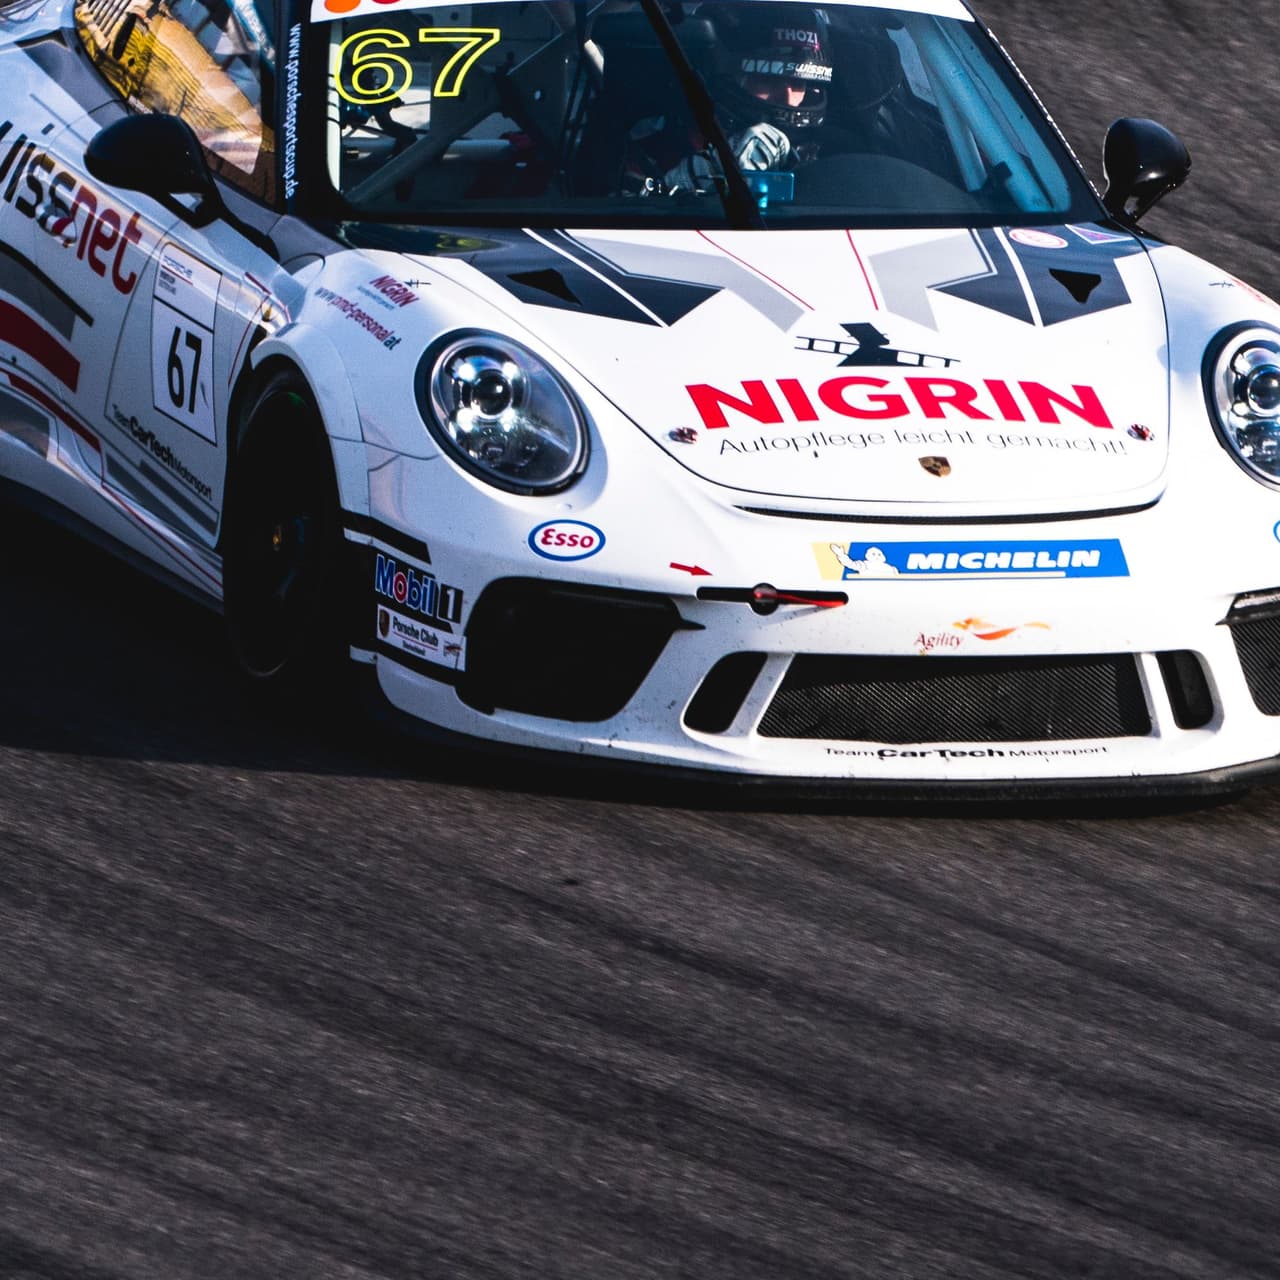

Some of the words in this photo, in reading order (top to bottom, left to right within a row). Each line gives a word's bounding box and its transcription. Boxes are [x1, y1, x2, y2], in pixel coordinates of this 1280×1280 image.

[334, 27, 500, 104] 67
[283, 23, 302, 199] www.porschesportscup.de
[369, 275, 420, 308] NIGRIN
[166, 325, 203, 415] 67
[684, 376, 1115, 430] NIGRIN
[130, 416, 175, 468] CarTech
[719, 429, 886, 456] Autopflege
[894, 428, 975, 446] leicht
[987, 432, 1129, 456] gemacht!
[541, 528, 594, 548] Esso
[906, 550, 1101, 570] MICHELIN
[375, 553, 436, 617] Mobil
[392, 616, 420, 640] Porsche
[420, 628, 439, 647] Club
[913, 632, 964, 651] Agility
[823, 747, 875, 757] Team
[877, 748, 1005, 759] CarTech
[1008, 746, 1109, 757] Motorsport
